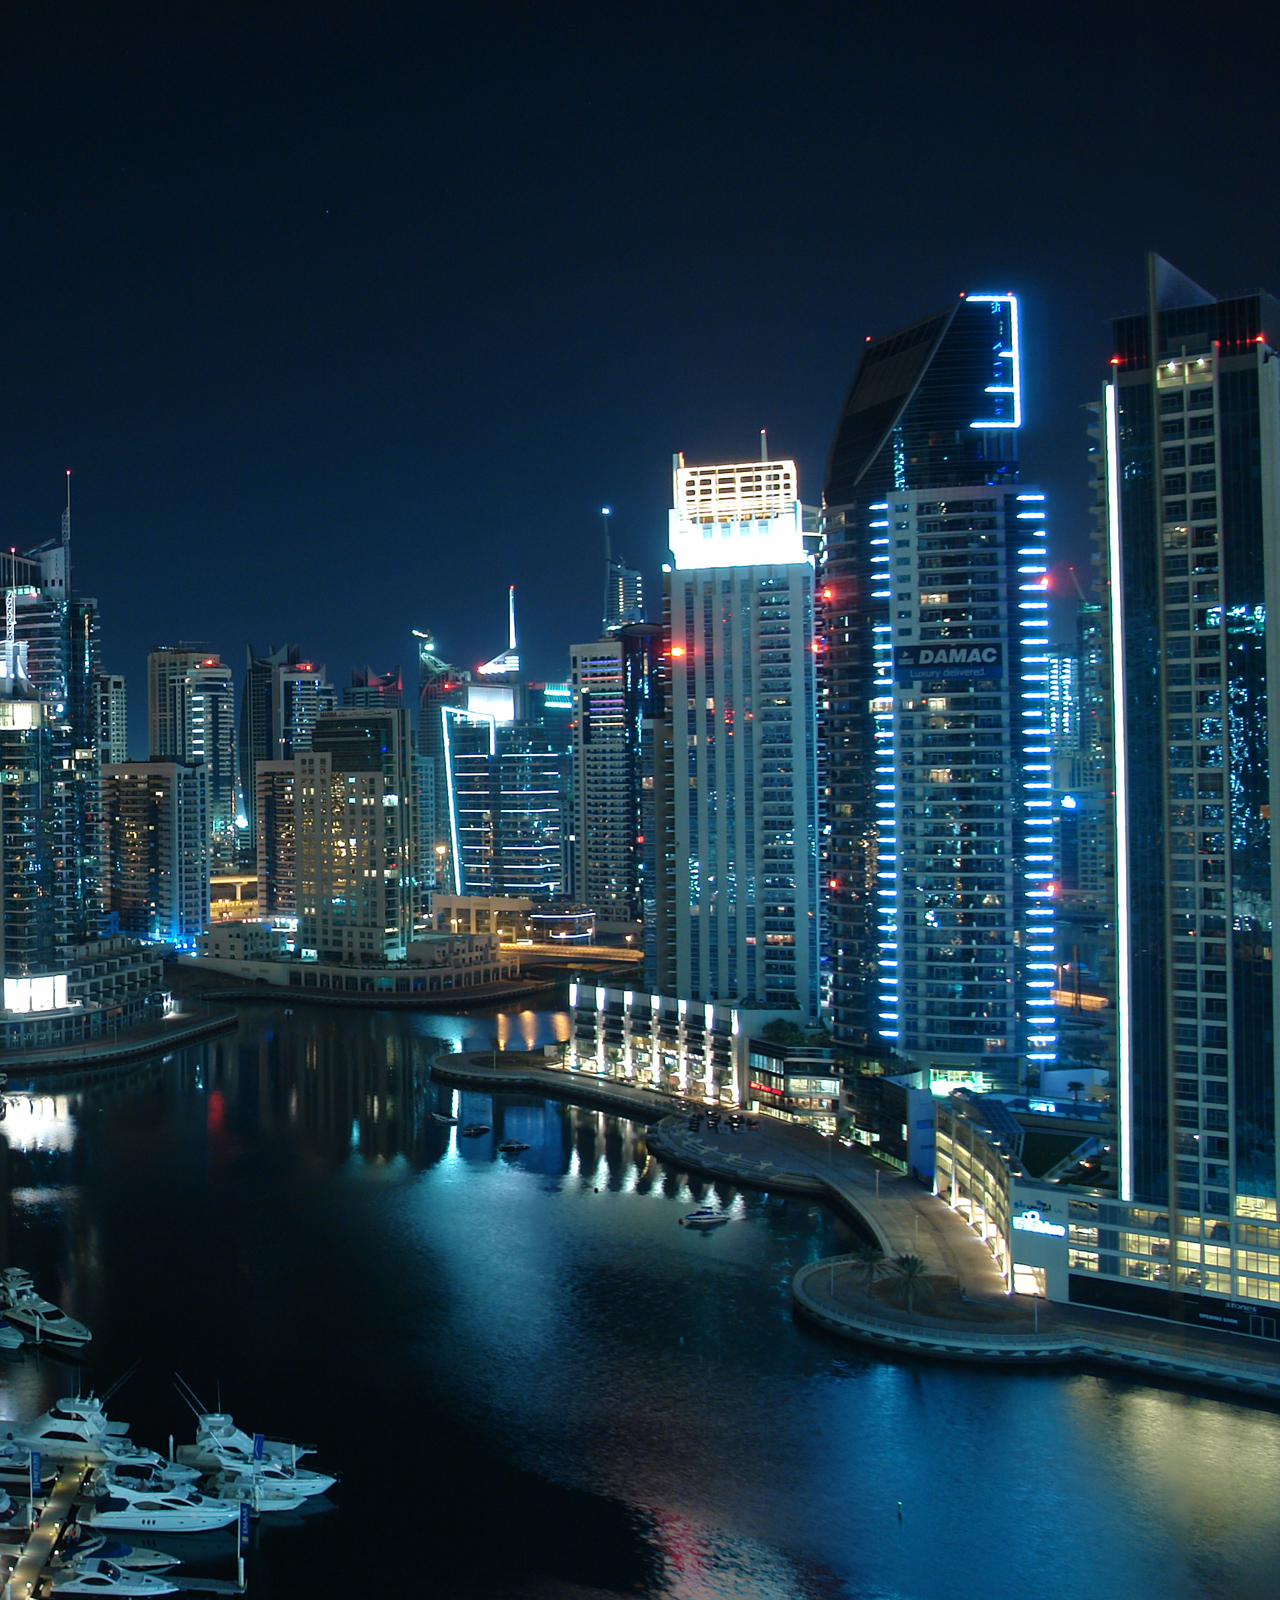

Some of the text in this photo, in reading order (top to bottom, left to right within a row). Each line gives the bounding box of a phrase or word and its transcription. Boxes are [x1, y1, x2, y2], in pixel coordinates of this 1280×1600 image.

[918, 647, 997, 665] DAMAC
[910, 667, 987, 678] Luxury delivered.
[1225, 1302, 1257, 1312] stones
